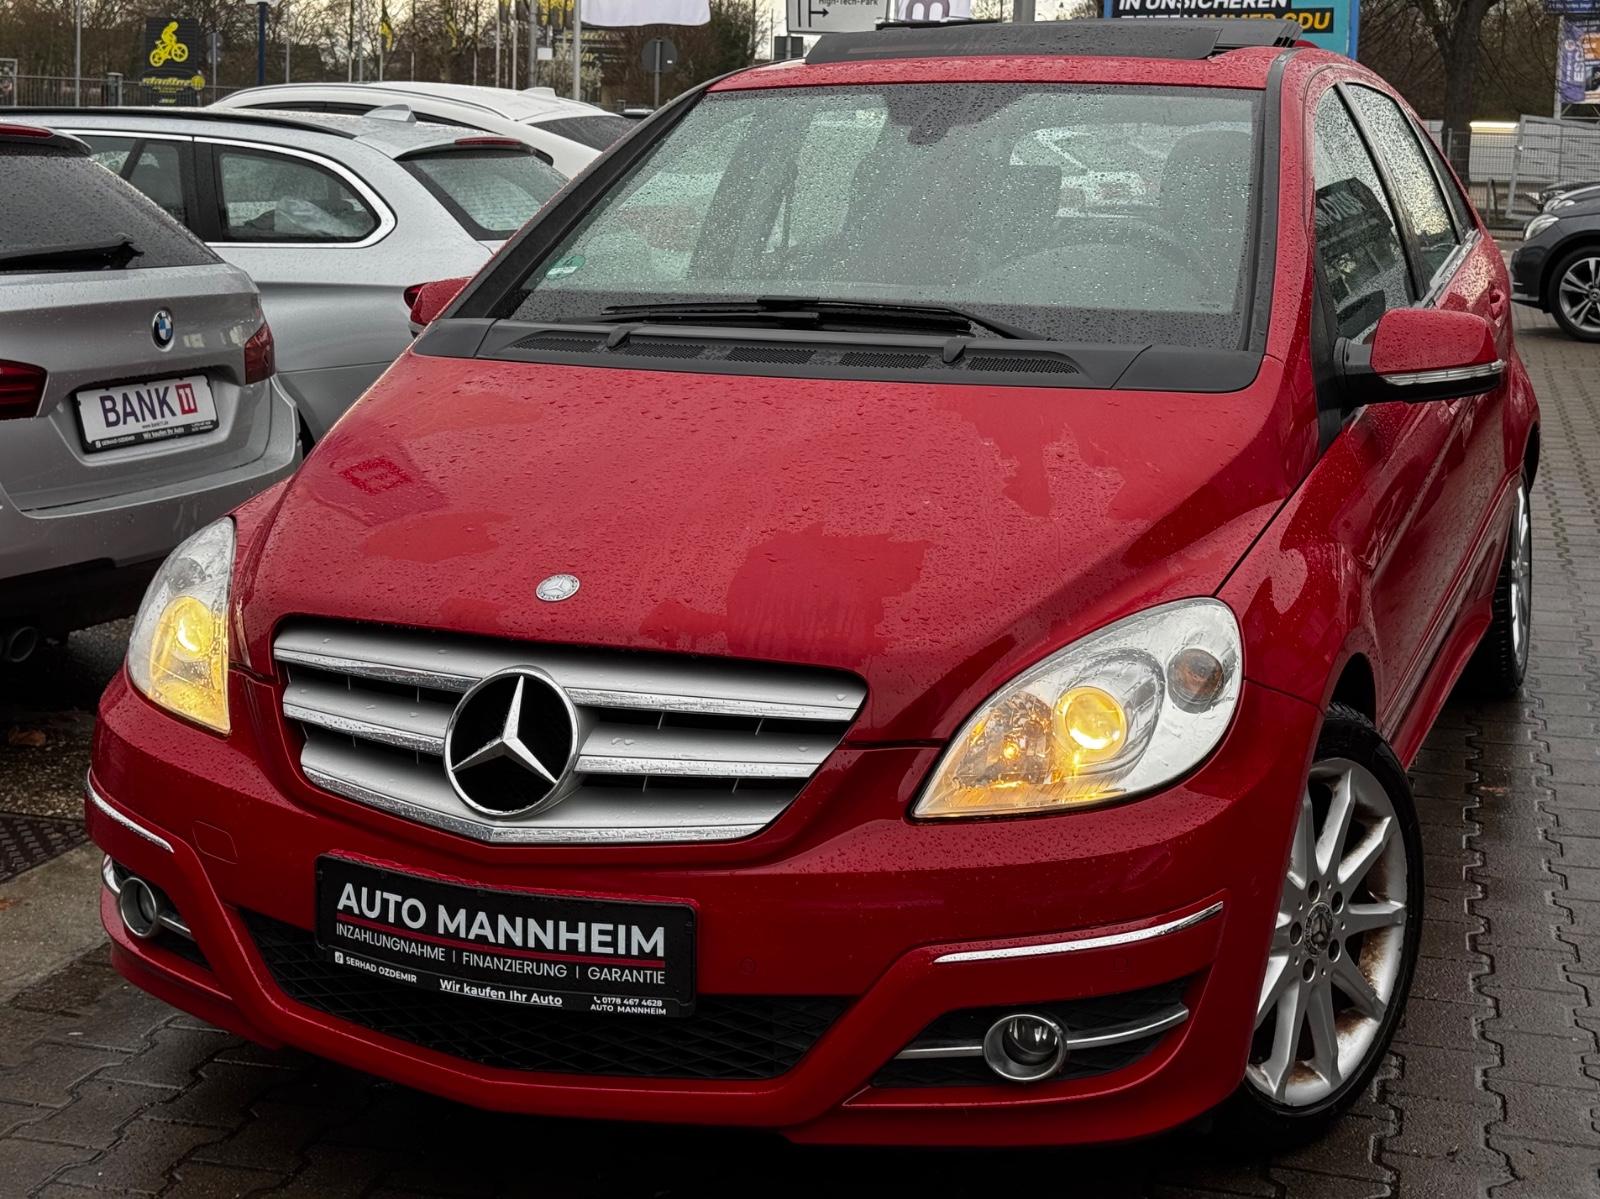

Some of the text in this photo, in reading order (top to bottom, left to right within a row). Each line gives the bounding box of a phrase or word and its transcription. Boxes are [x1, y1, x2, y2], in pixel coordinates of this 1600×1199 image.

[99, 386, 177, 428] BANK
[336, 882, 666, 957] AUTO MANNHEIM
[336, 922, 666, 985] INZAHLUNGNAHME FINANZIERUNG GARANTIE
[345, 956, 417, 983] SERHAD OZDEMIR
[440, 978, 563, 1006] Wir kaufen Ihr Auto
[602, 996, 663, 1007] 0178 467 4628
[590, 1003, 667, 1015] AUTO MANNHEIM
